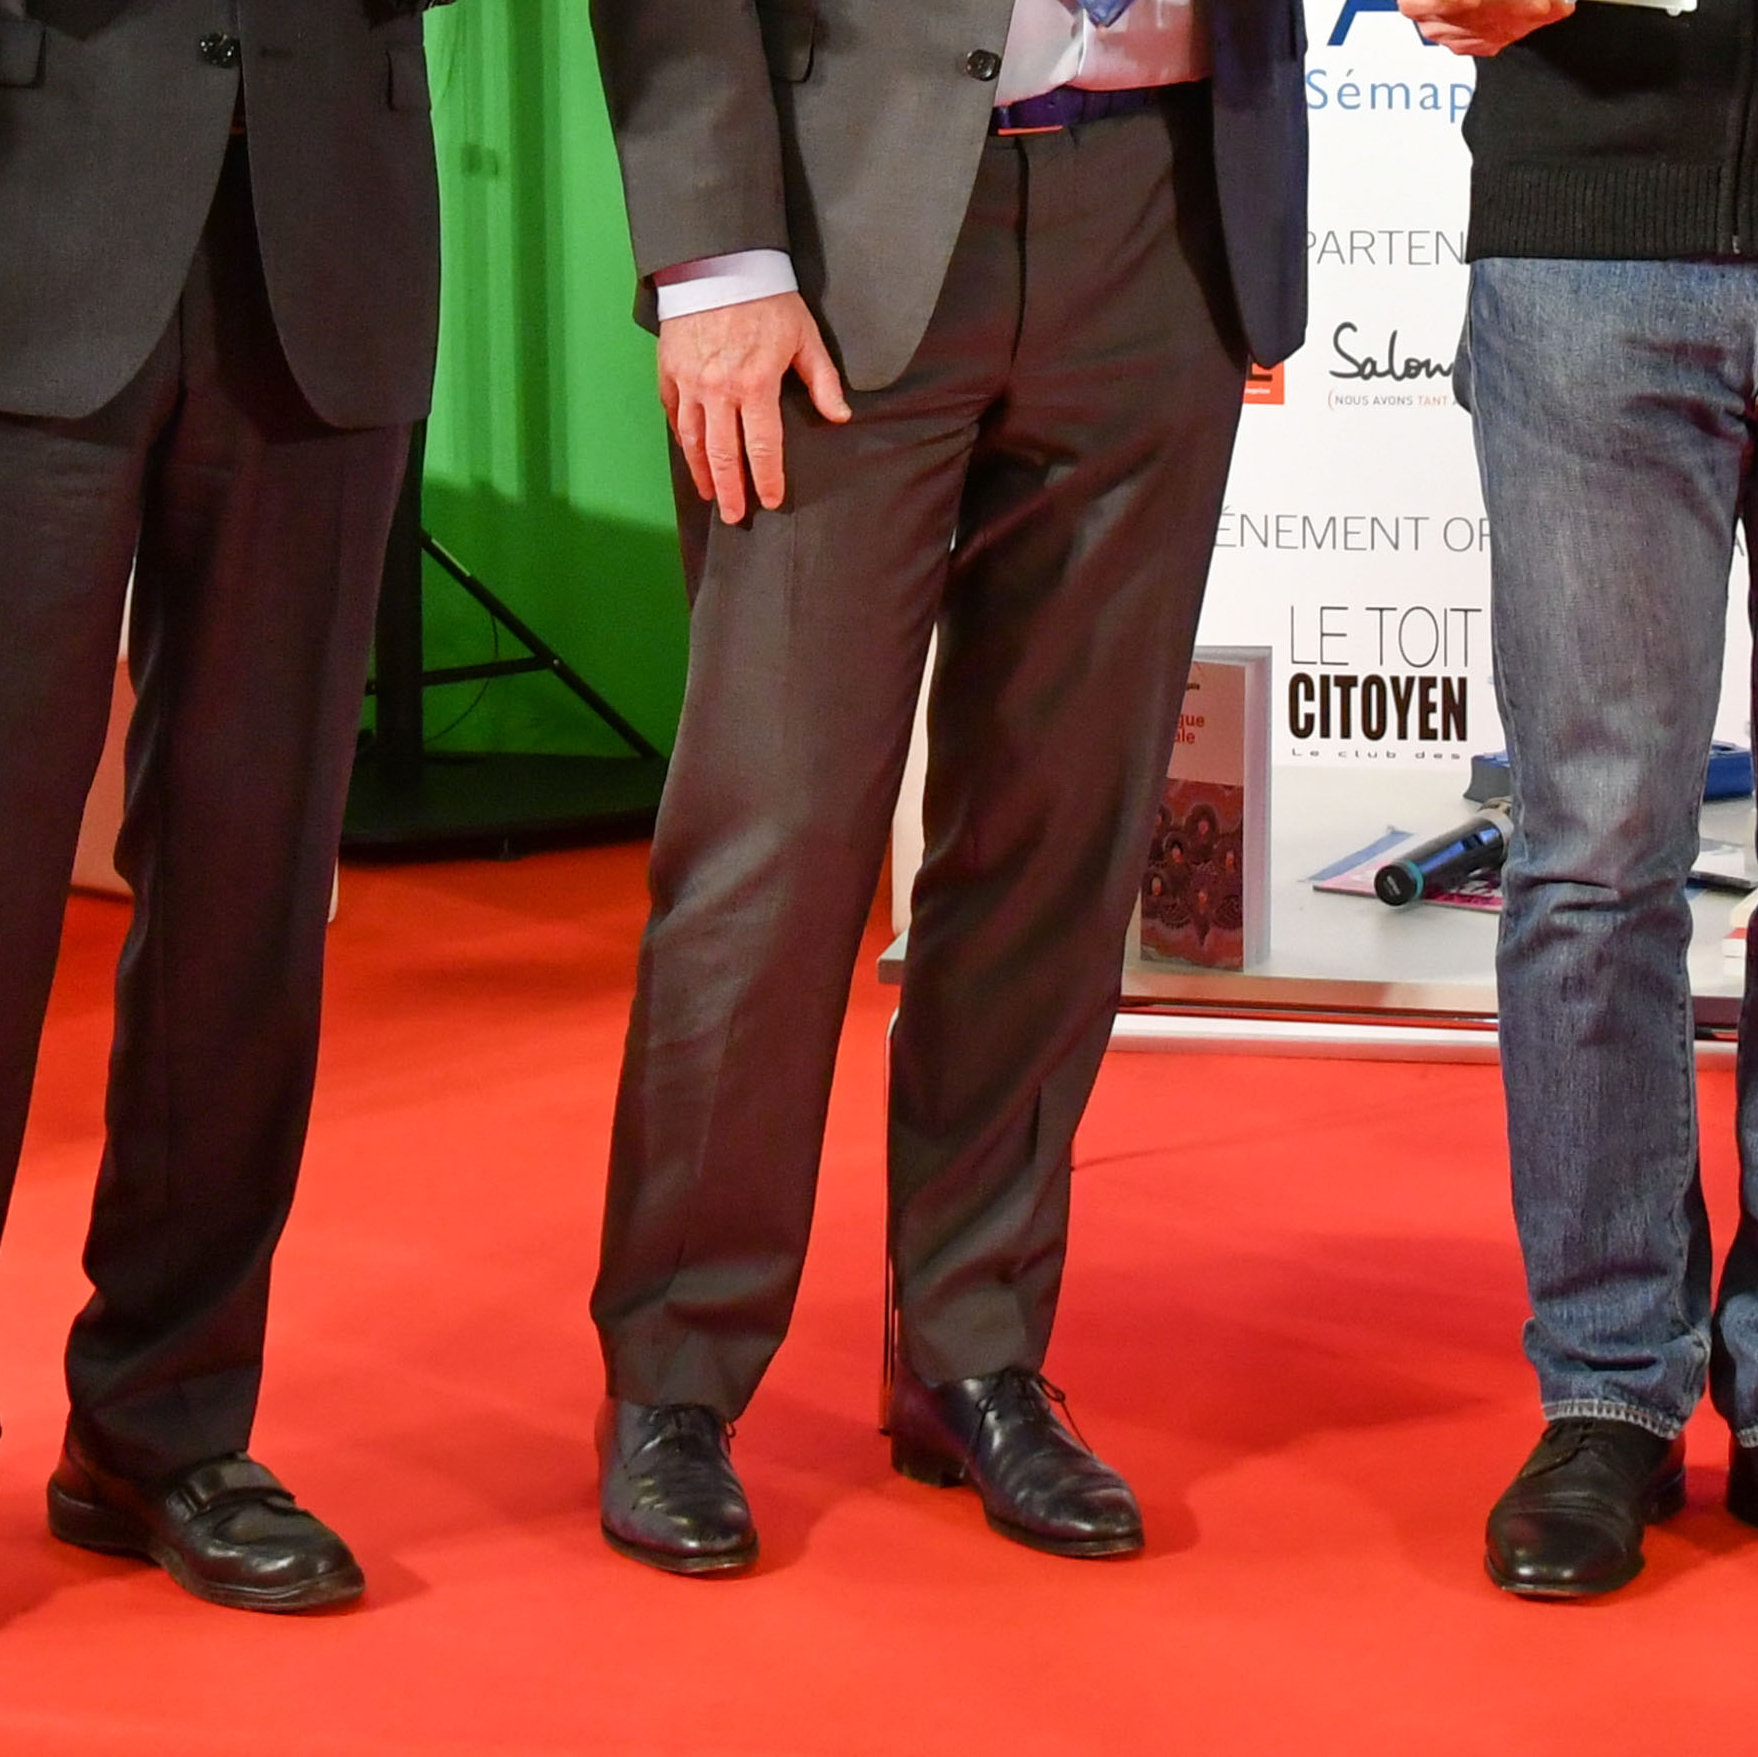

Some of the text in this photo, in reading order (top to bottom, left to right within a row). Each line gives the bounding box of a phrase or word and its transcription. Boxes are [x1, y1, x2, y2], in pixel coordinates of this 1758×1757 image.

[1372, 395, 1413, 406] AVONS
[1417, 395, 1448, 407] TANT
[1290, 604, 1482, 668] LE TOIT
[1288, 672, 1468, 742] CITOYEN
[1338, 750, 1397, 759] club
[1415, 751, 1460, 760] des
